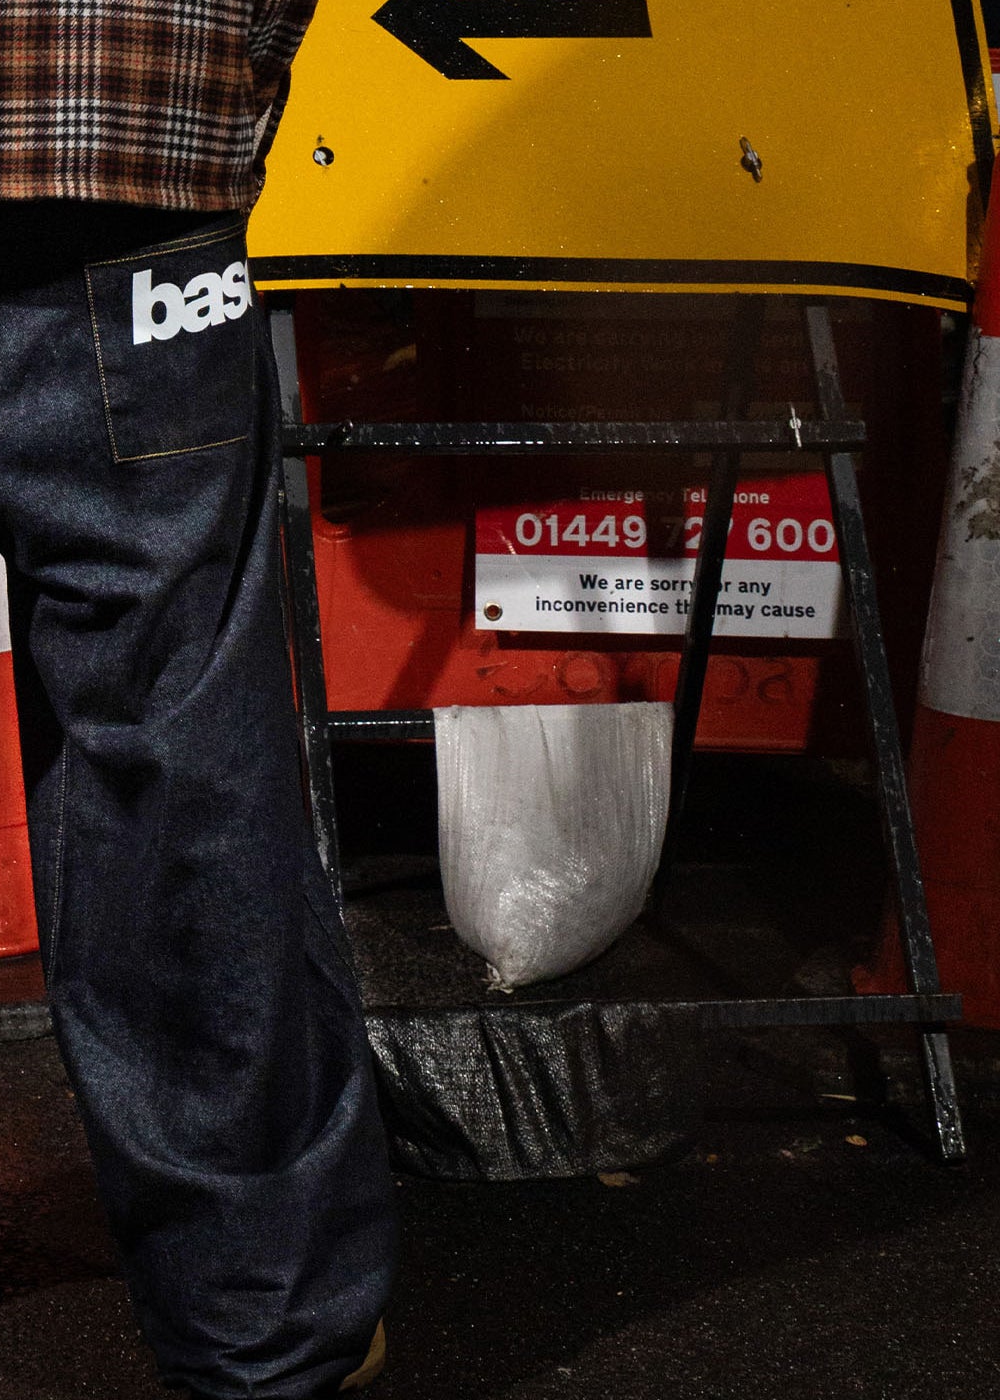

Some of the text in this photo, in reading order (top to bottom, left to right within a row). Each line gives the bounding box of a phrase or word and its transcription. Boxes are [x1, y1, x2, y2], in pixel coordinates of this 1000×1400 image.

[132, 261, 252, 345] bas
[580, 486, 769, 505] Emergency Telone
[515, 513, 836, 553] 01449 72 600
[579, 573, 608, 590] We
[615, 578, 644, 591] are
[738, 580, 772, 596] any
[535, 596, 670, 614] inconvenience
[717, 604, 755, 619] may
[761, 604, 816, 618] cause
